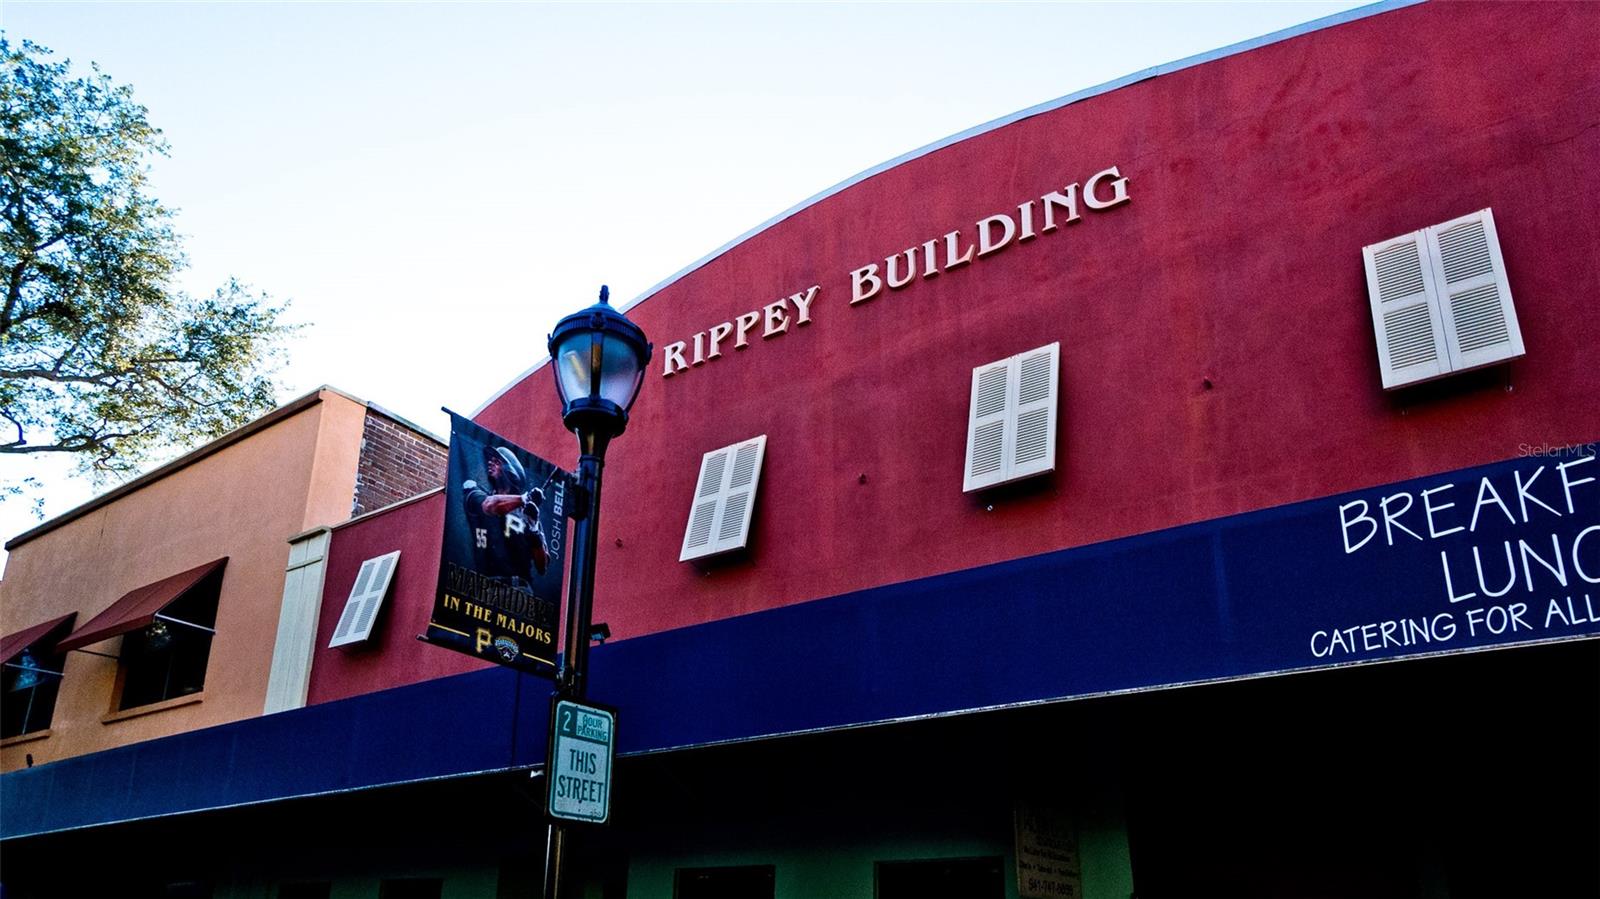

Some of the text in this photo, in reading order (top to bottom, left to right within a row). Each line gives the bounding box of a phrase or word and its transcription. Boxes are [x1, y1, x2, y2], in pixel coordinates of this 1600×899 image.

[662, 166, 1131, 377] RIPPEY BUILDING
[1338, 455, 1597, 554] BREAKF
[550, 480, 566, 560] JOSH BELL
[475, 527, 489, 550] 55
[442, 593, 461, 612] IN
[465, 601, 493, 624] THE
[496, 612, 553, 645] MAJORS
[1310, 593, 1600, 658] CATERING FOR ALL
[475, 626, 494, 654] P
[563, 711, 572, 732] 2
[577, 725, 607, 741] PARKING
[582, 715, 603, 729] HOUR
[570, 749, 597, 775] THIS
[557, 775, 604, 803] STREET
